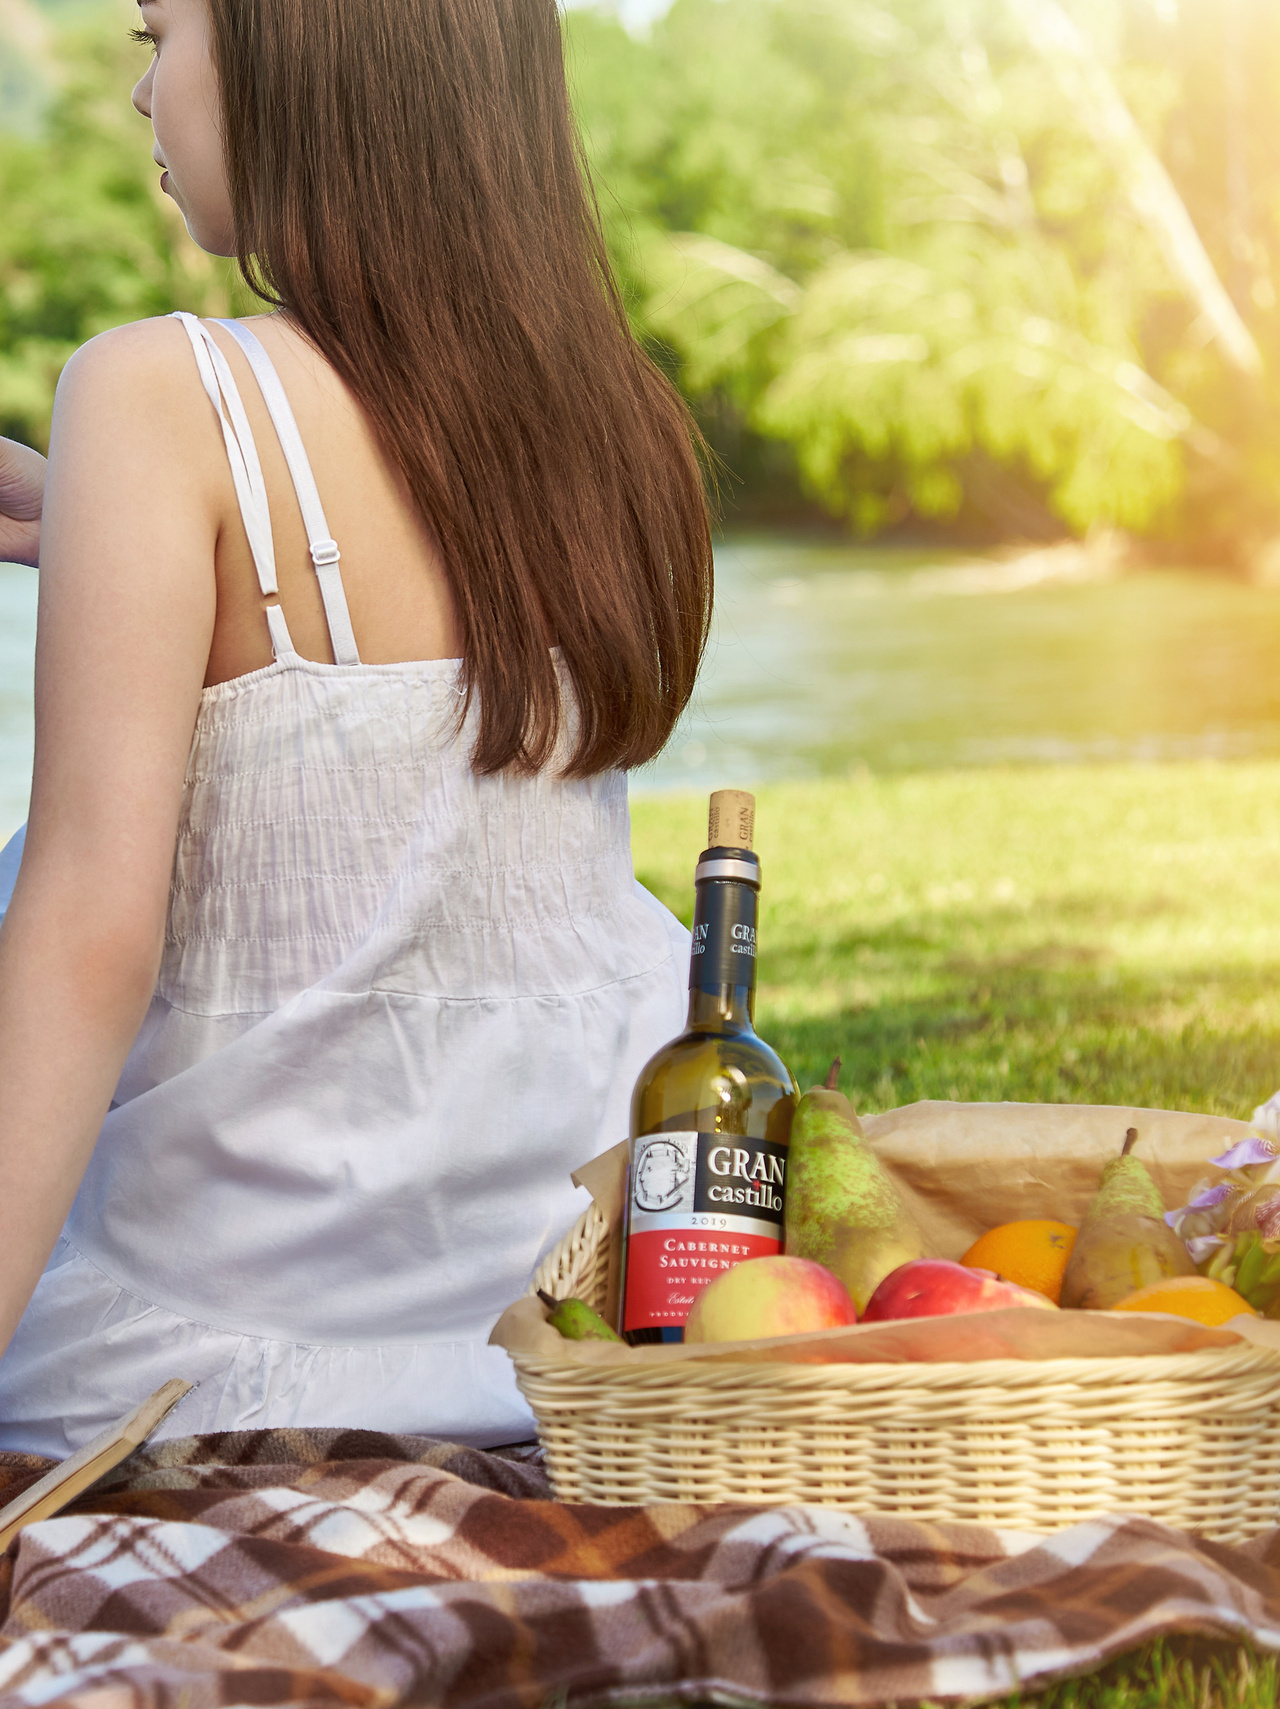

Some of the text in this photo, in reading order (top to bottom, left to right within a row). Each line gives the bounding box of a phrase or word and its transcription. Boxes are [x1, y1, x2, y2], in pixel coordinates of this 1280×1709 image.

[739, 806, 749, 840] GRAN
[694, 923, 710, 941] AN
[731, 923, 757, 943] GRA
[707, 1146, 786, 1186] GRAN
[707, 1183, 783, 1212] castillo
[691, 1217, 727, 1229] 2019
[663, 1238, 750, 1255] CABERNET
[660, 1255, 740, 1269] SAUVIGN
